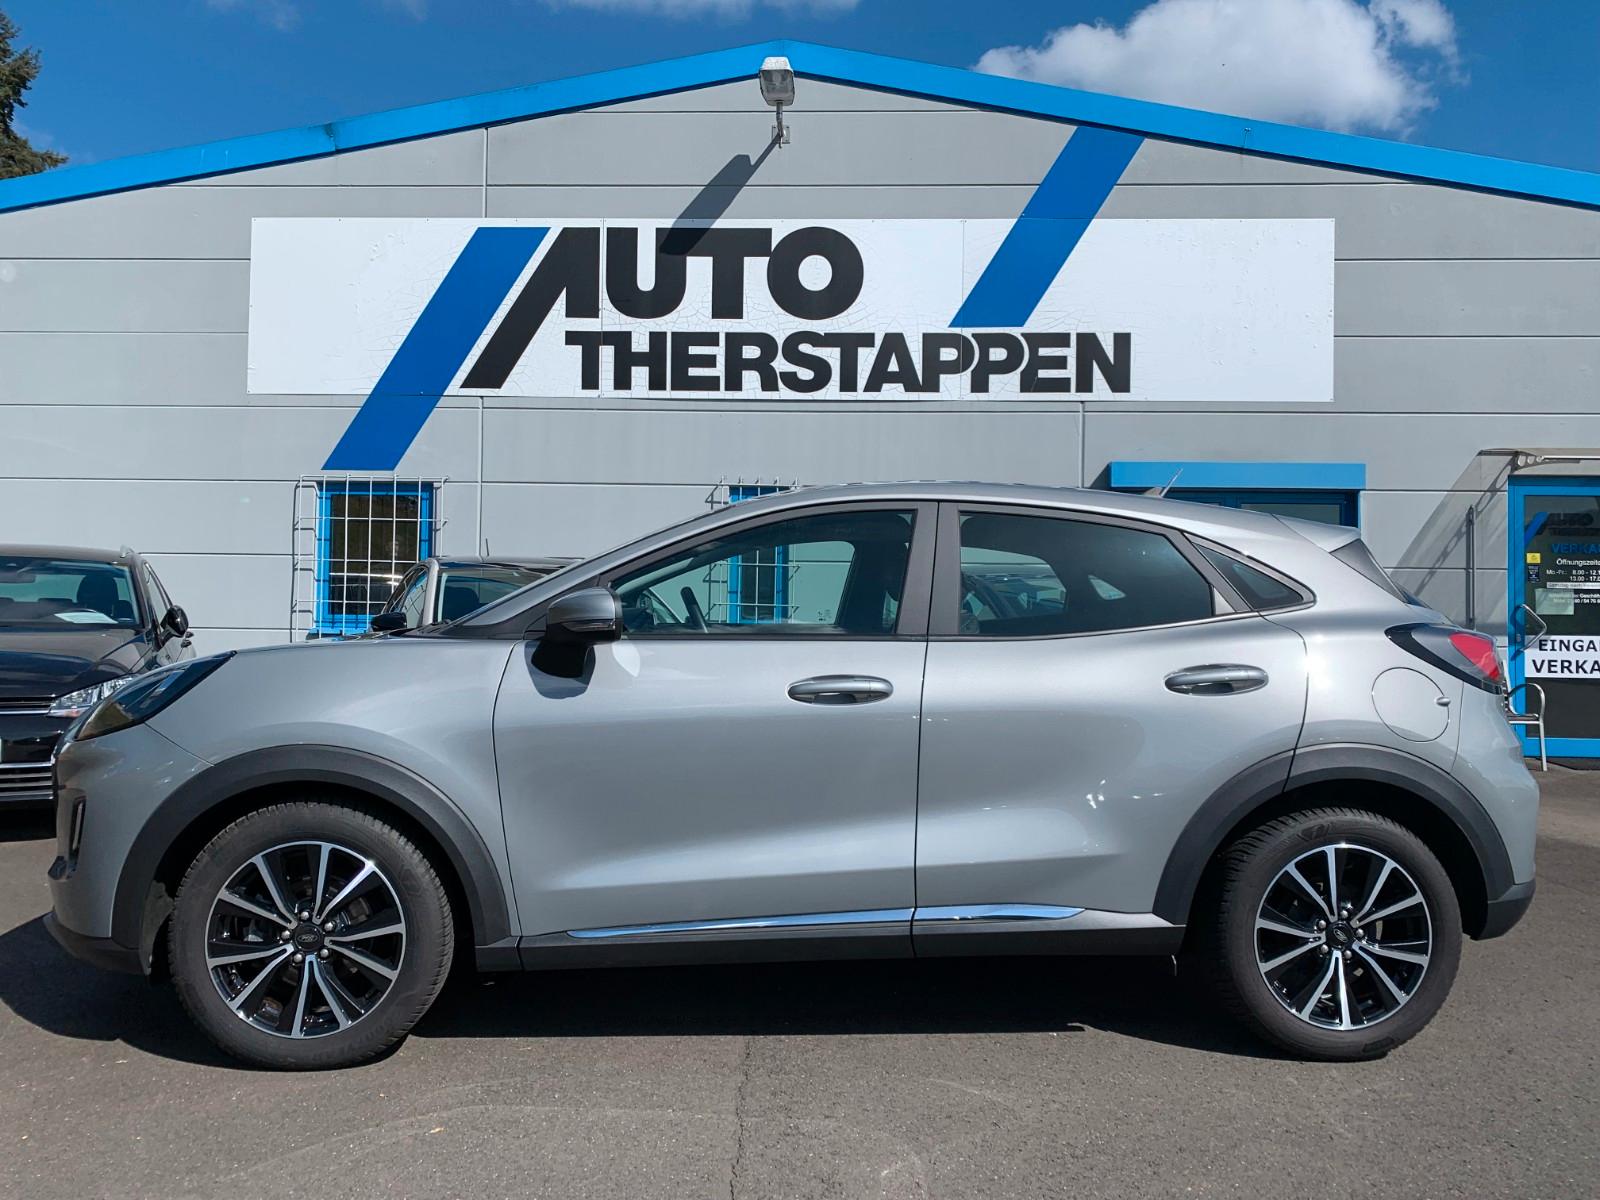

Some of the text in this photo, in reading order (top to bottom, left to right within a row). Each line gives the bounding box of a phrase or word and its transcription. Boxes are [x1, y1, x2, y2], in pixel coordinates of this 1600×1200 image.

[461, 226, 865, 389] AUTO
[565, 330, 1132, 394] THERSTAPPEN
[1538, 639, 1600, 652] EINGA
